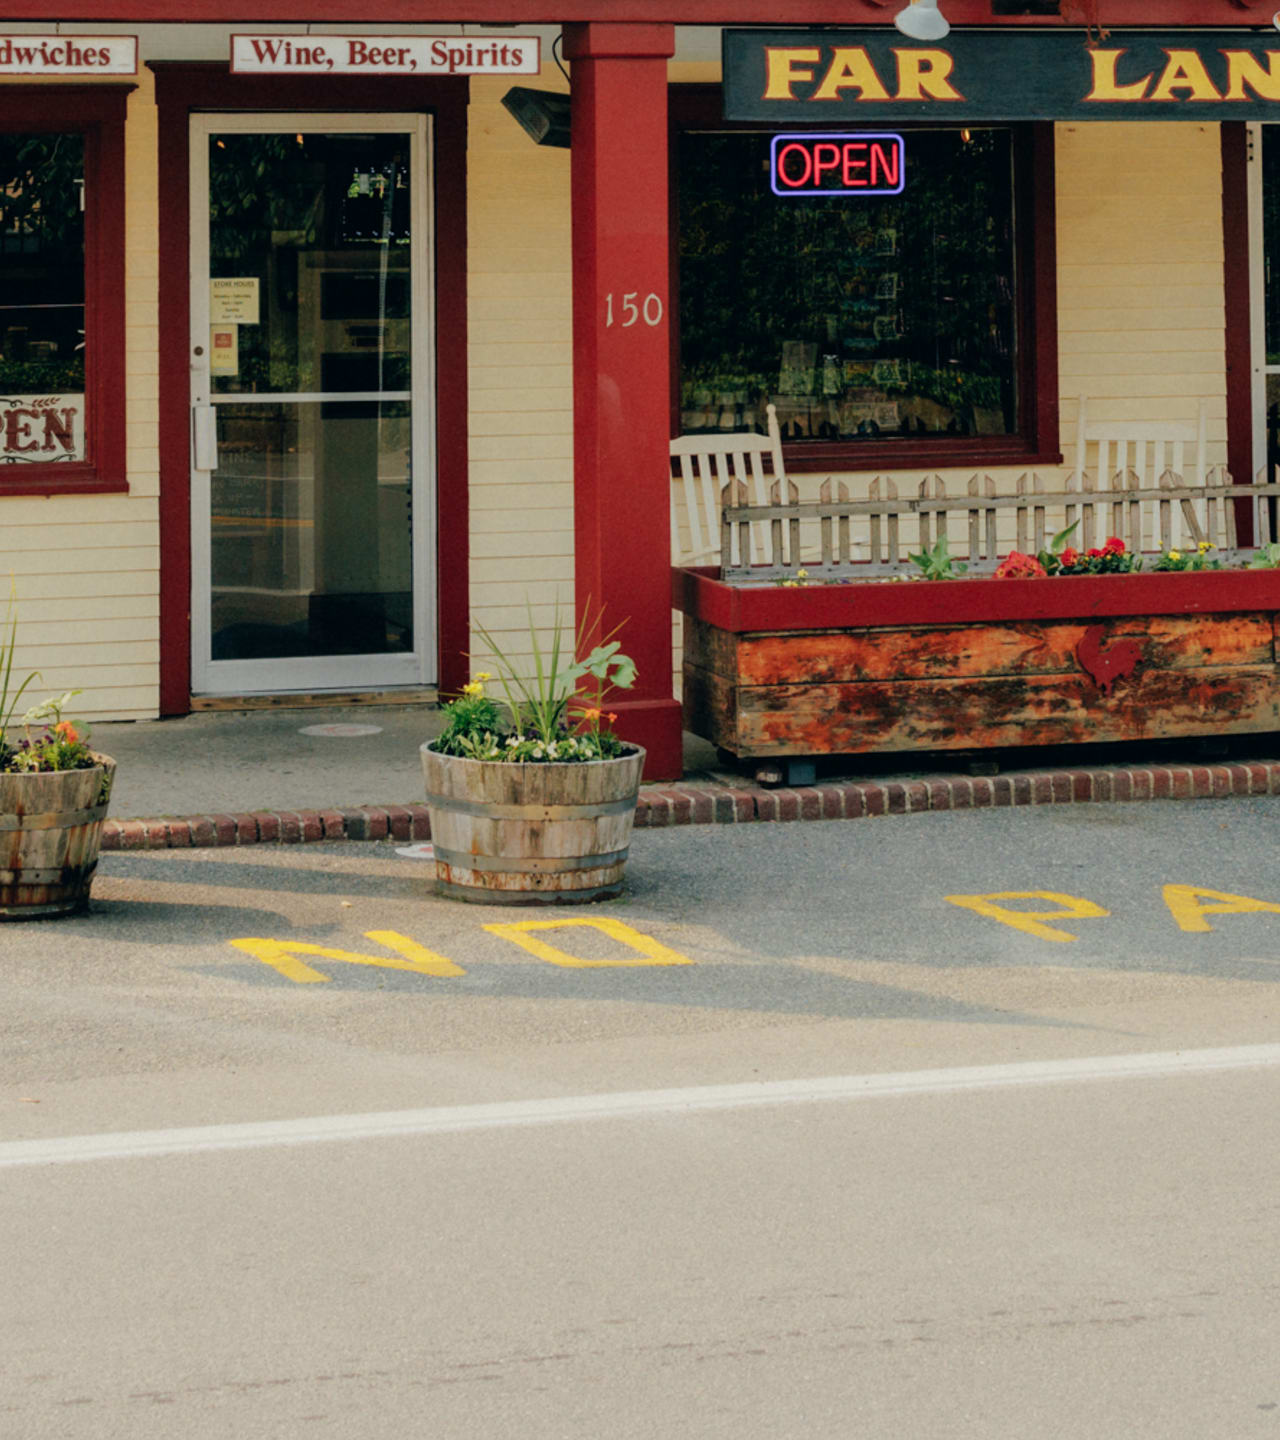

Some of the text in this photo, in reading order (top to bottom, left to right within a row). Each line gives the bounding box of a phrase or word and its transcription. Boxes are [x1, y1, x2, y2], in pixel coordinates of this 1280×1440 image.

[250, 39, 524, 74] Wine, Beer, Spirits
[761, 45, 968, 103] FAR
[776, 143, 899, 188] OPEN
[605, 291, 663, 329] 150
[228, 915, 697, 985] NO
